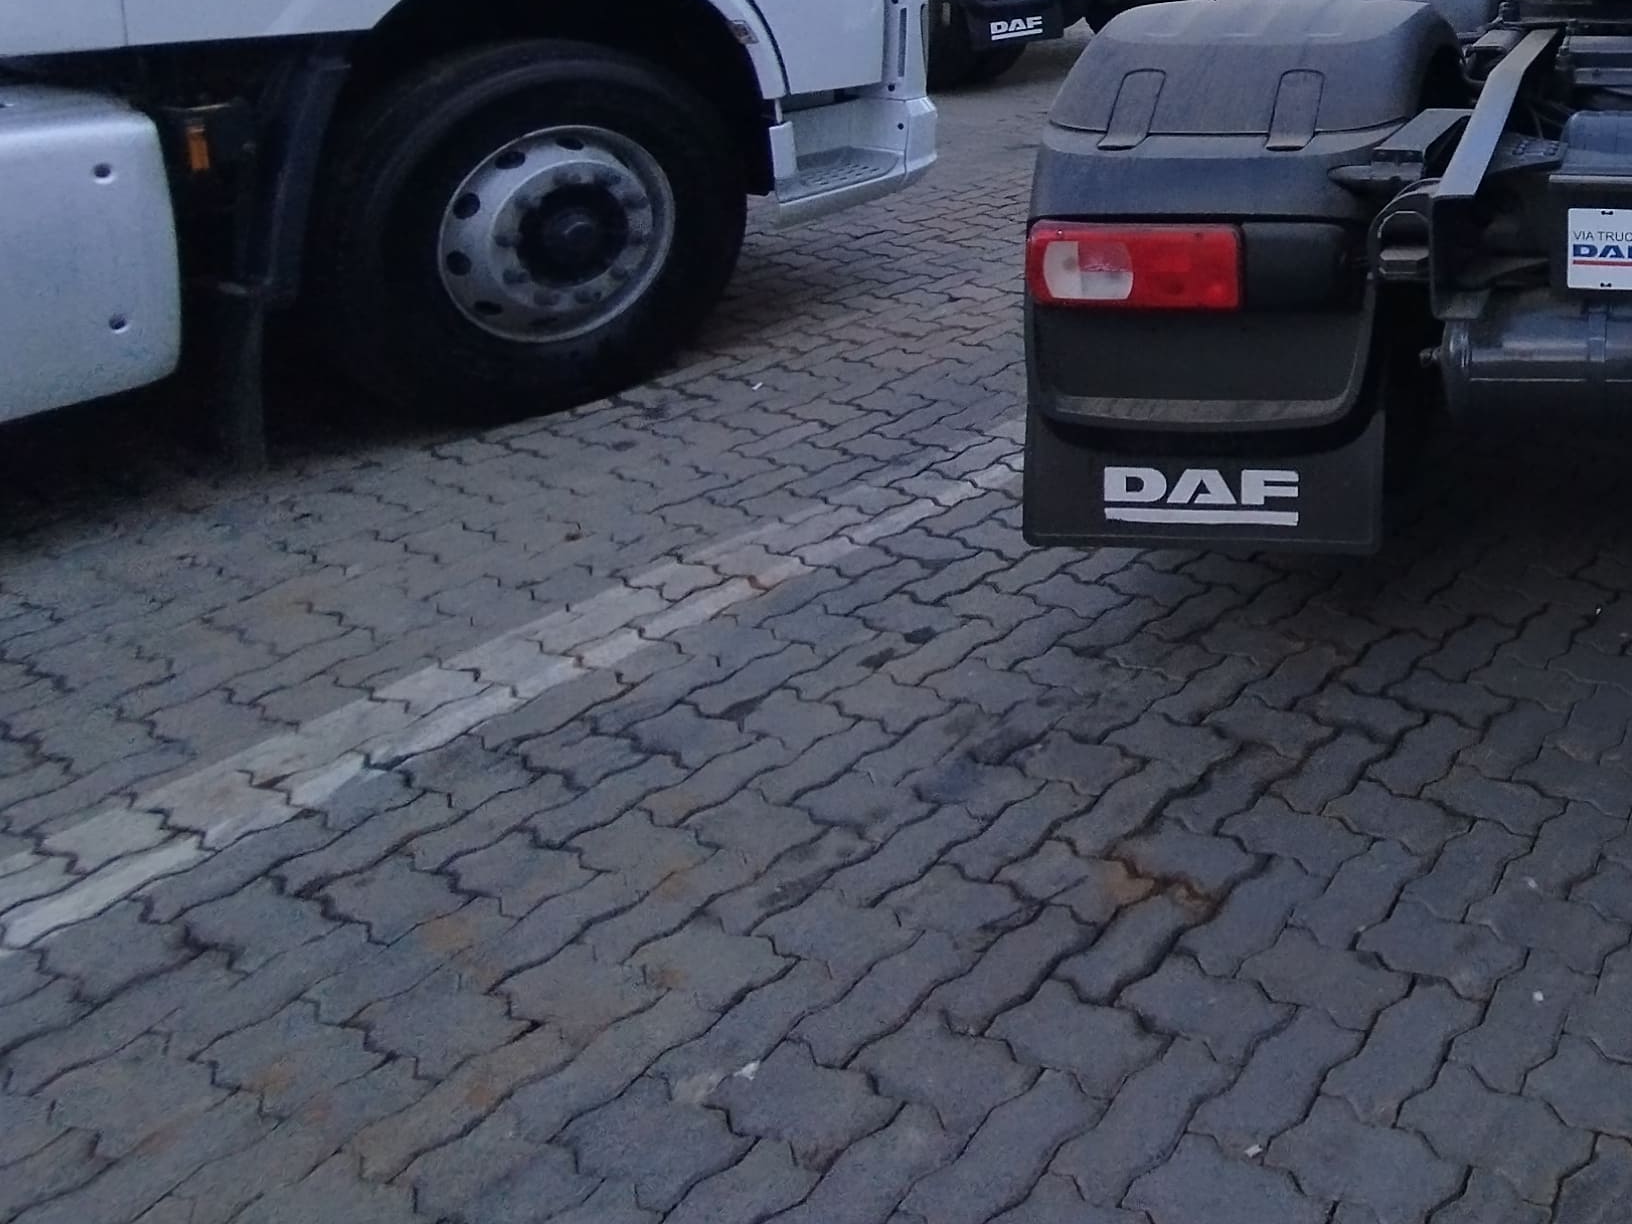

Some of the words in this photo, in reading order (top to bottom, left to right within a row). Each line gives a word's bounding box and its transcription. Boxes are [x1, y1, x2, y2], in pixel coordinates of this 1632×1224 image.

[990, 16, 1043, 34] DAF
[1572, 230, 1595, 242] VIA
[1104, 466, 1299, 505] DAF
